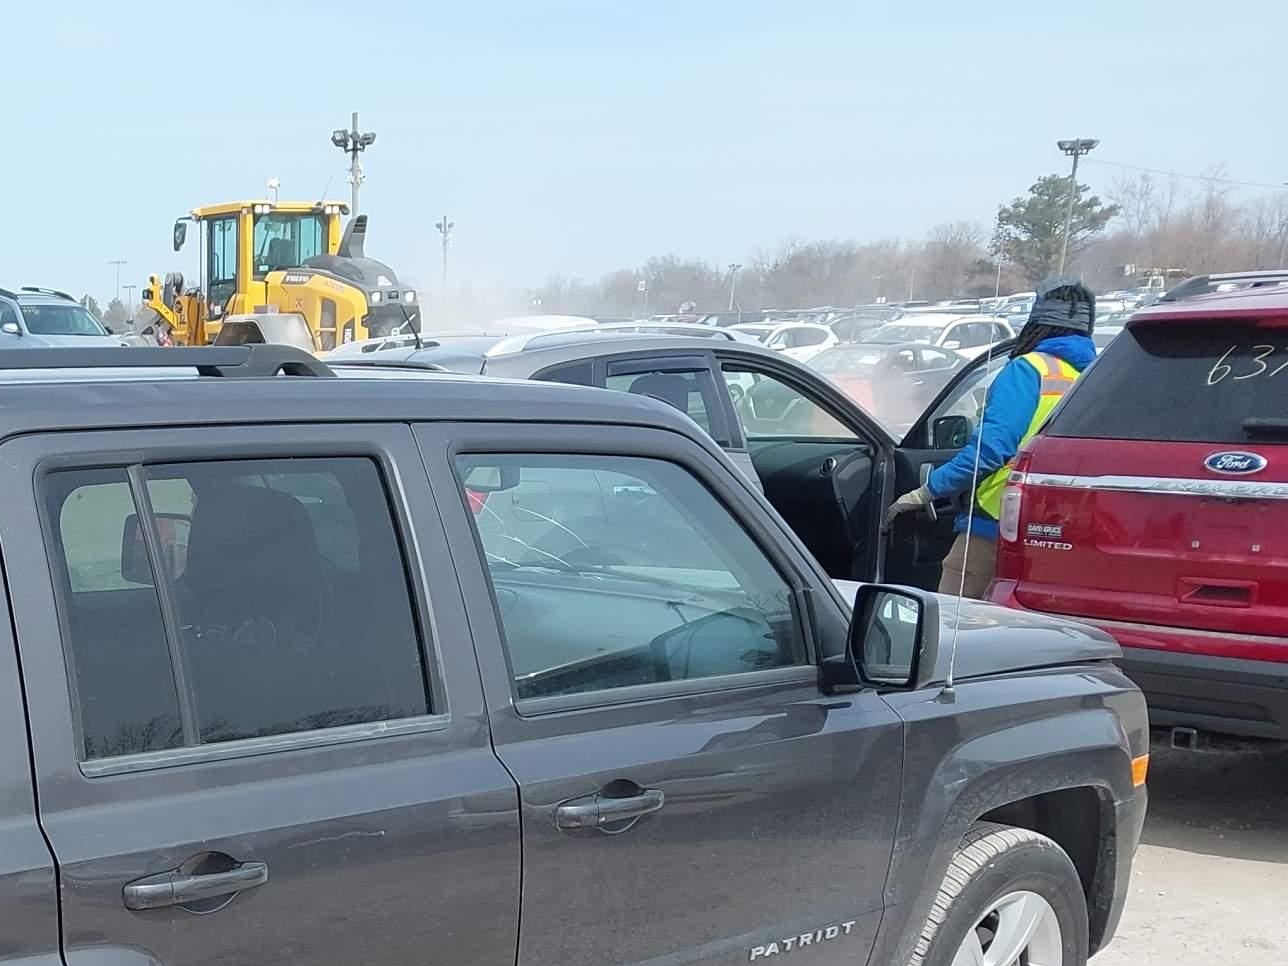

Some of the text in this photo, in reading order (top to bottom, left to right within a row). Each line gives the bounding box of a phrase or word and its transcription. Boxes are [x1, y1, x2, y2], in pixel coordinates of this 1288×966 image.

[1216, 455, 1251, 469] Ford
[1023, 538, 1073, 551] LIMITED
[749, 920, 857, 961] PATRIOT
